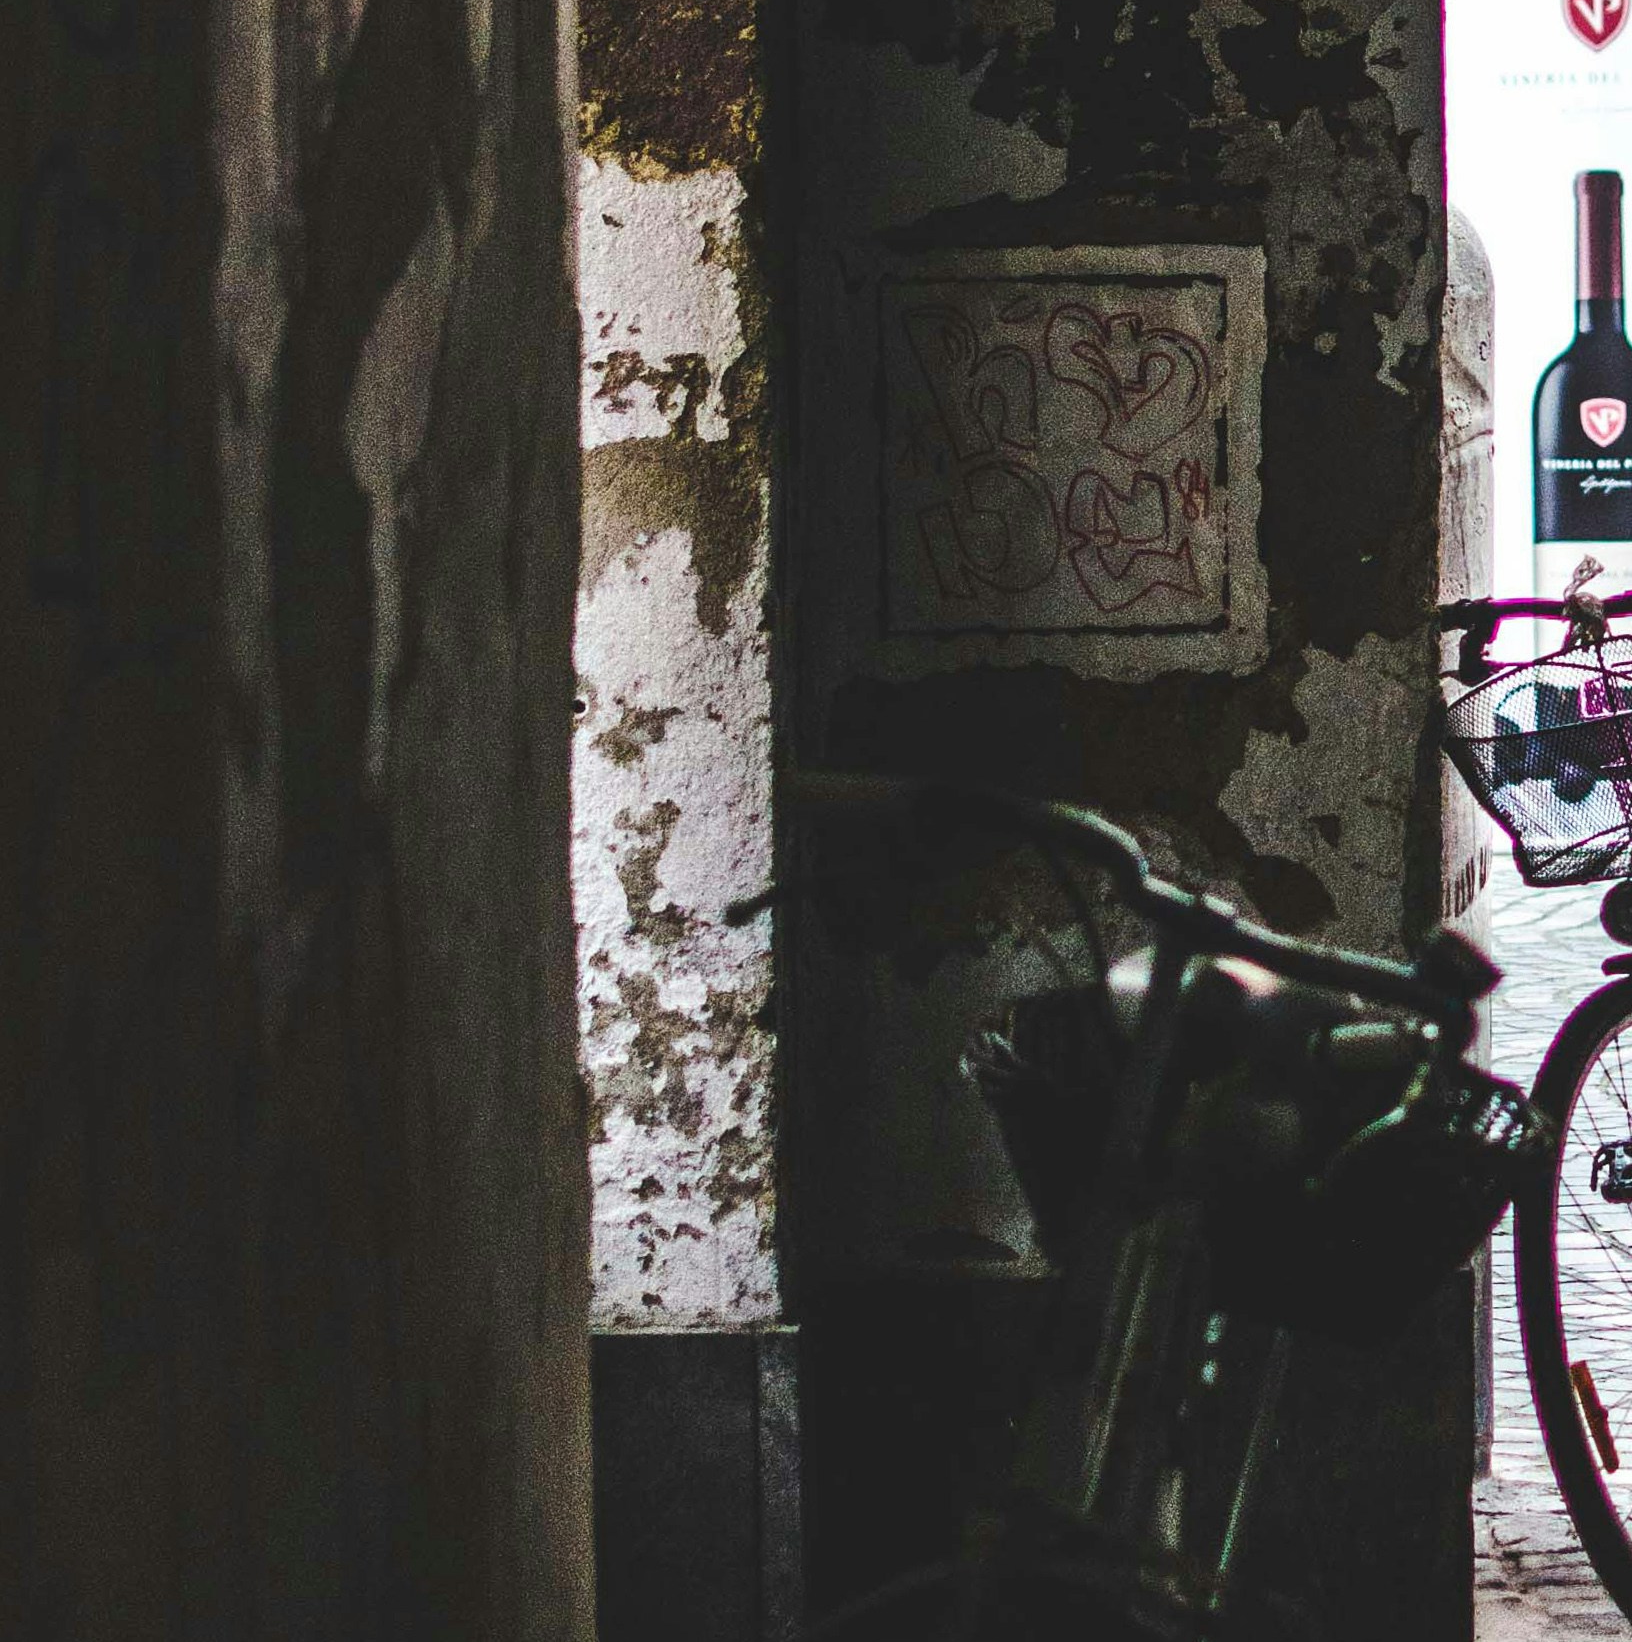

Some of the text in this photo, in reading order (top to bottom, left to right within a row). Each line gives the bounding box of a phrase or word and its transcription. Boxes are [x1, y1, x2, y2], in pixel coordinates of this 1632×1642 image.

[1500, 71, 1577, 86] VINERIA
[1588, 70, 1621, 85] DEL
[1596, 459, 1621, 470] DEL
